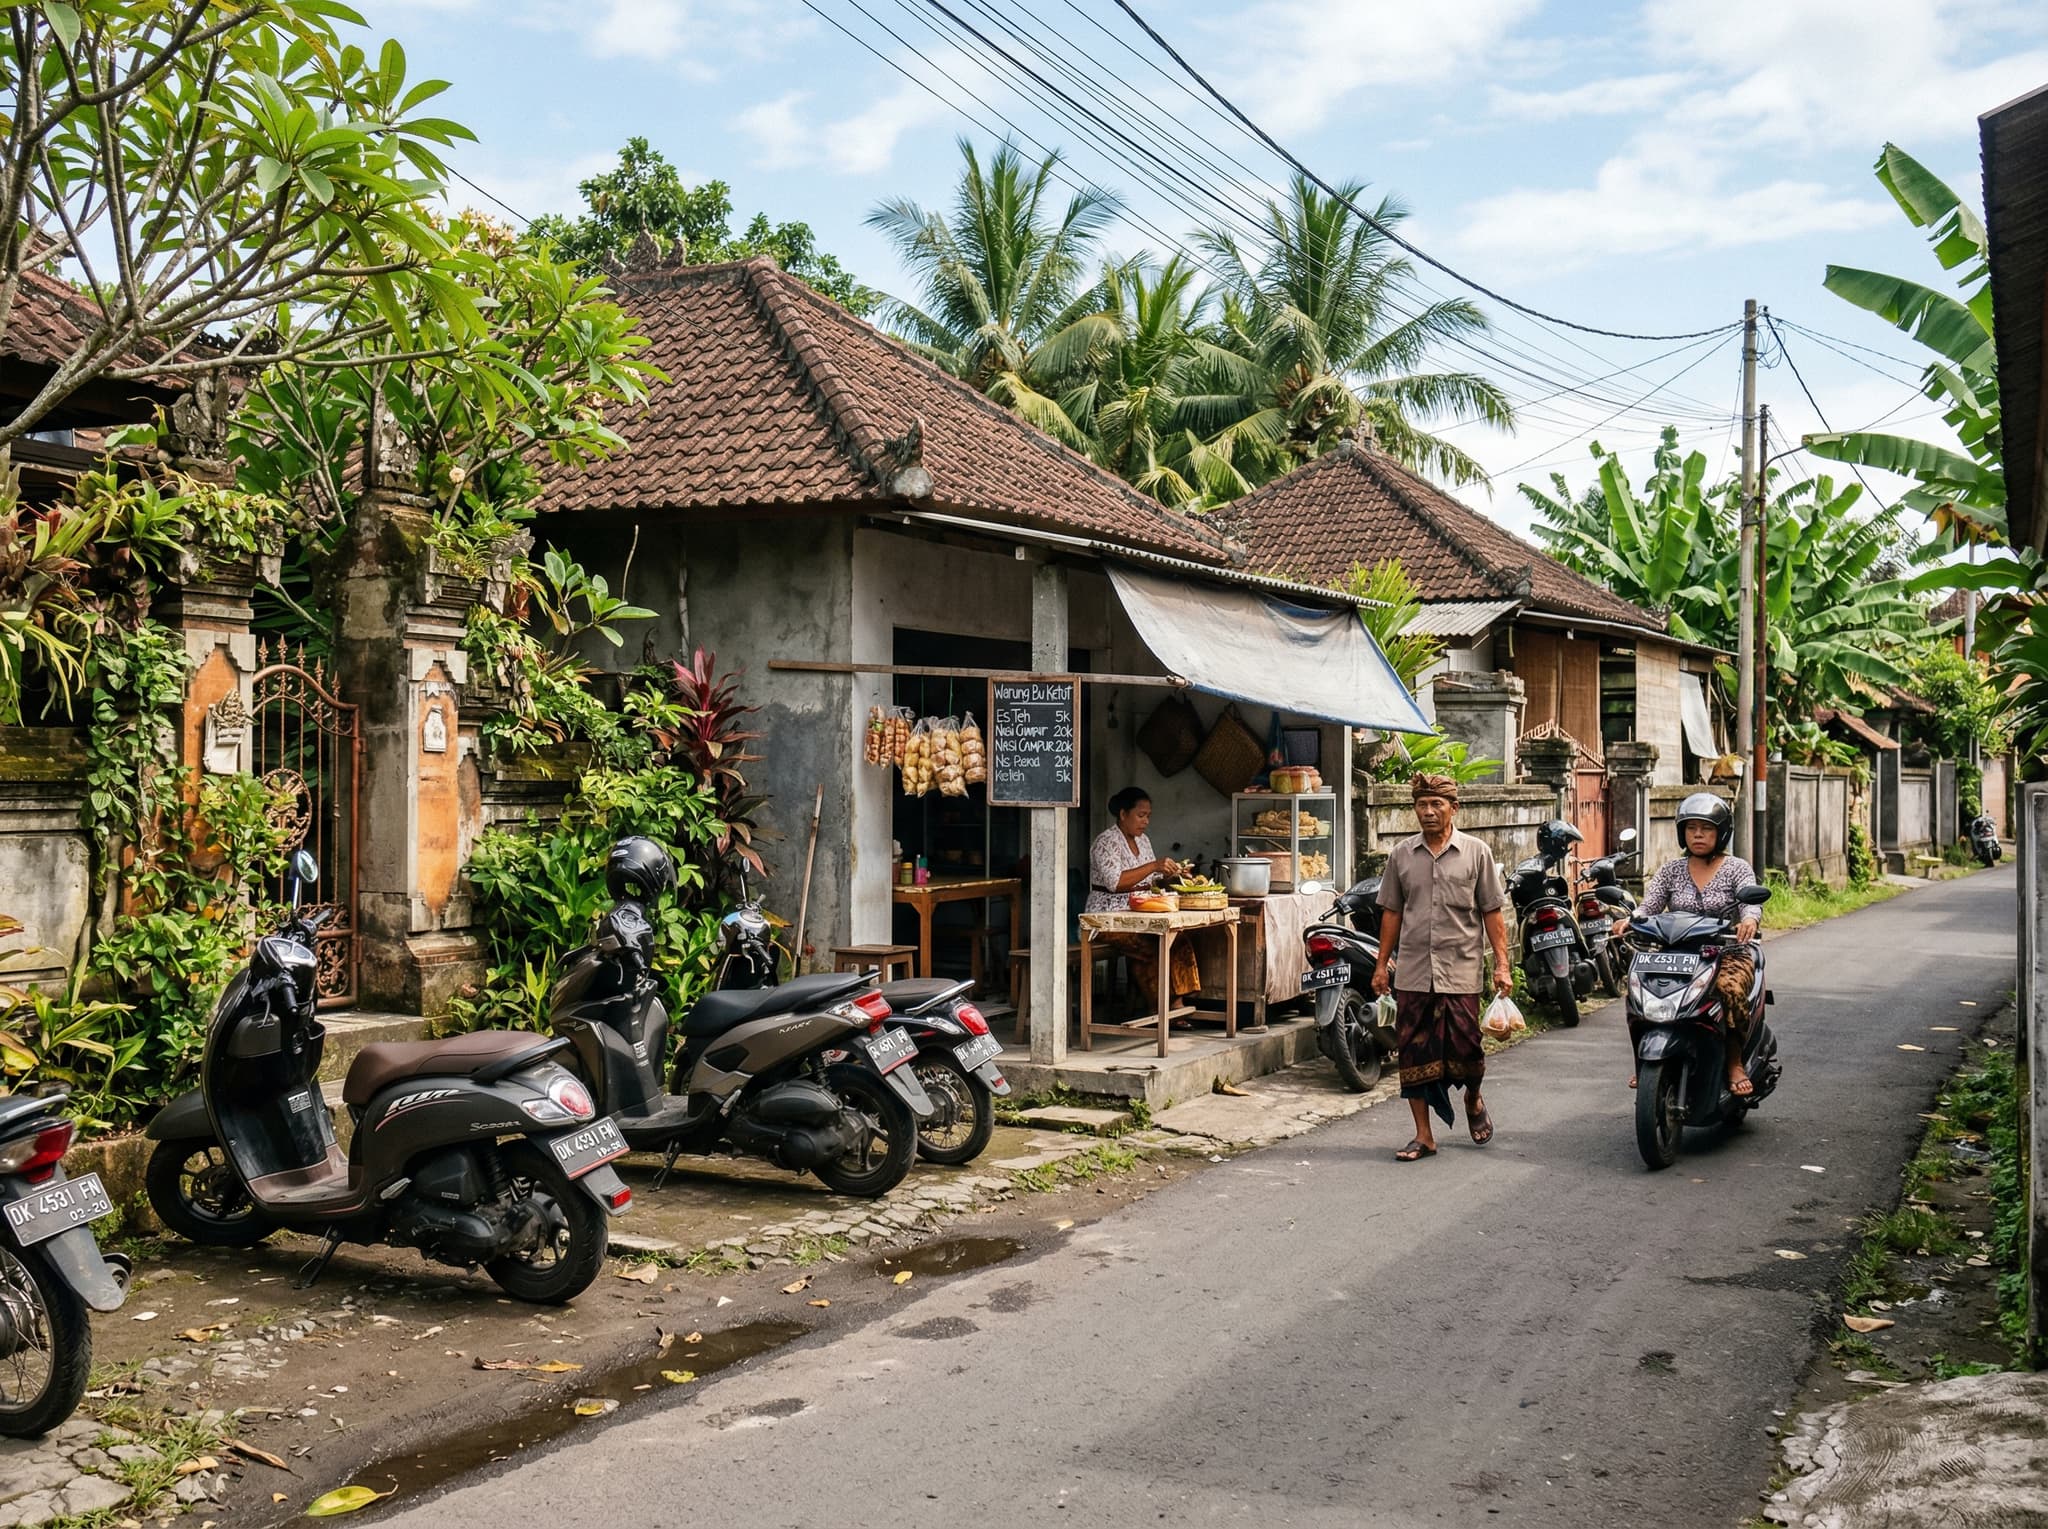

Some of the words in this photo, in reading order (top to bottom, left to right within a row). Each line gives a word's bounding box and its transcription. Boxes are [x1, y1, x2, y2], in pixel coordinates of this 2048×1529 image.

[994, 684, 1030, 702] Warung
[1032, 684, 1044, 701] Bu
[1046, 684, 1074, 701] Ketut
[996, 709, 1010, 723] Es
[1010, 708, 1031, 723] Teh
[1055, 710, 1071, 723] 5k
[1053, 724, 1073, 738] 20k
[1055, 740, 1073, 753] 20k
[1054, 755, 1073, 768] 20k
[1056, 769, 1072, 783] 5k
[556, 1141, 575, 1160] DK
[9, 1202, 36, 1226] DK
[39, 1188, 76, 1214] 4531
[78, 1178, 101, 1200] FN
